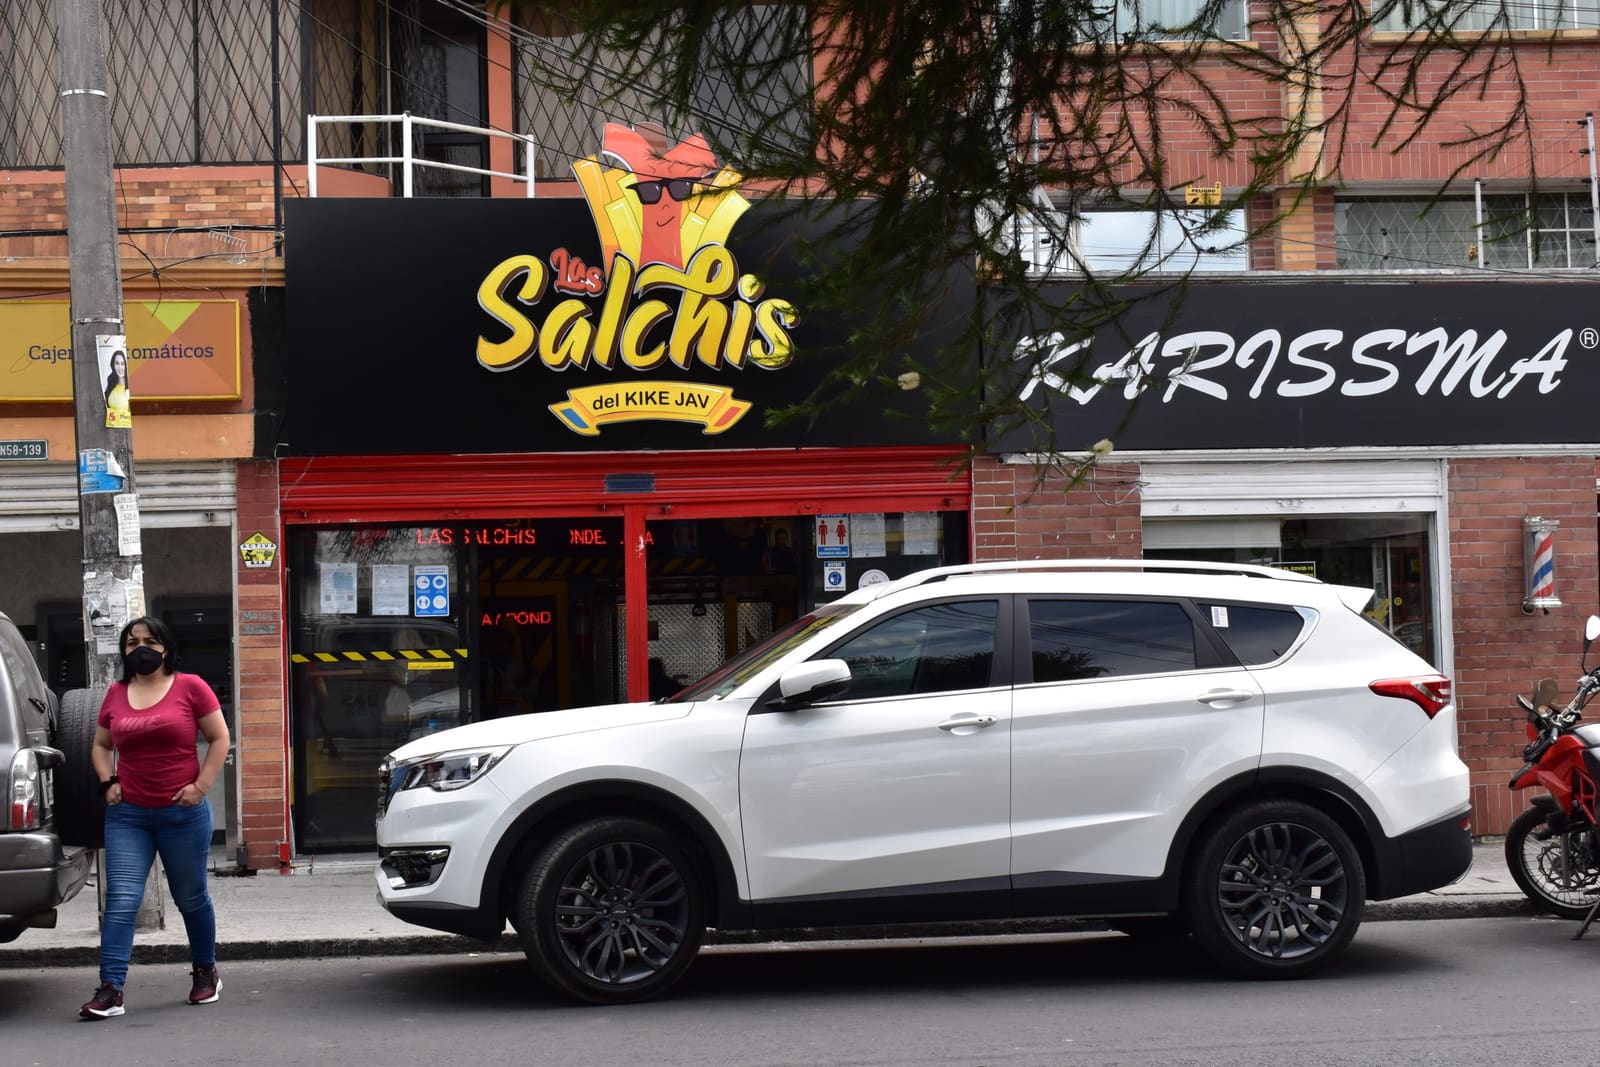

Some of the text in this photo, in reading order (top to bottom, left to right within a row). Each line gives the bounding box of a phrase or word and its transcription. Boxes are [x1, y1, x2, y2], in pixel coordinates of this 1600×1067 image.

[550, 248, 605, 297] Las
[476, 242, 800, 371] Salchis
[28, 344, 214, 364] Cajer tomáticos
[1012, 326, 1573, 405] KARISSMA
[592, 390, 710, 410] del KIKE JAV
[0, 444, 41, 456] N58-139
[416, 527, 453, 545] LAS
